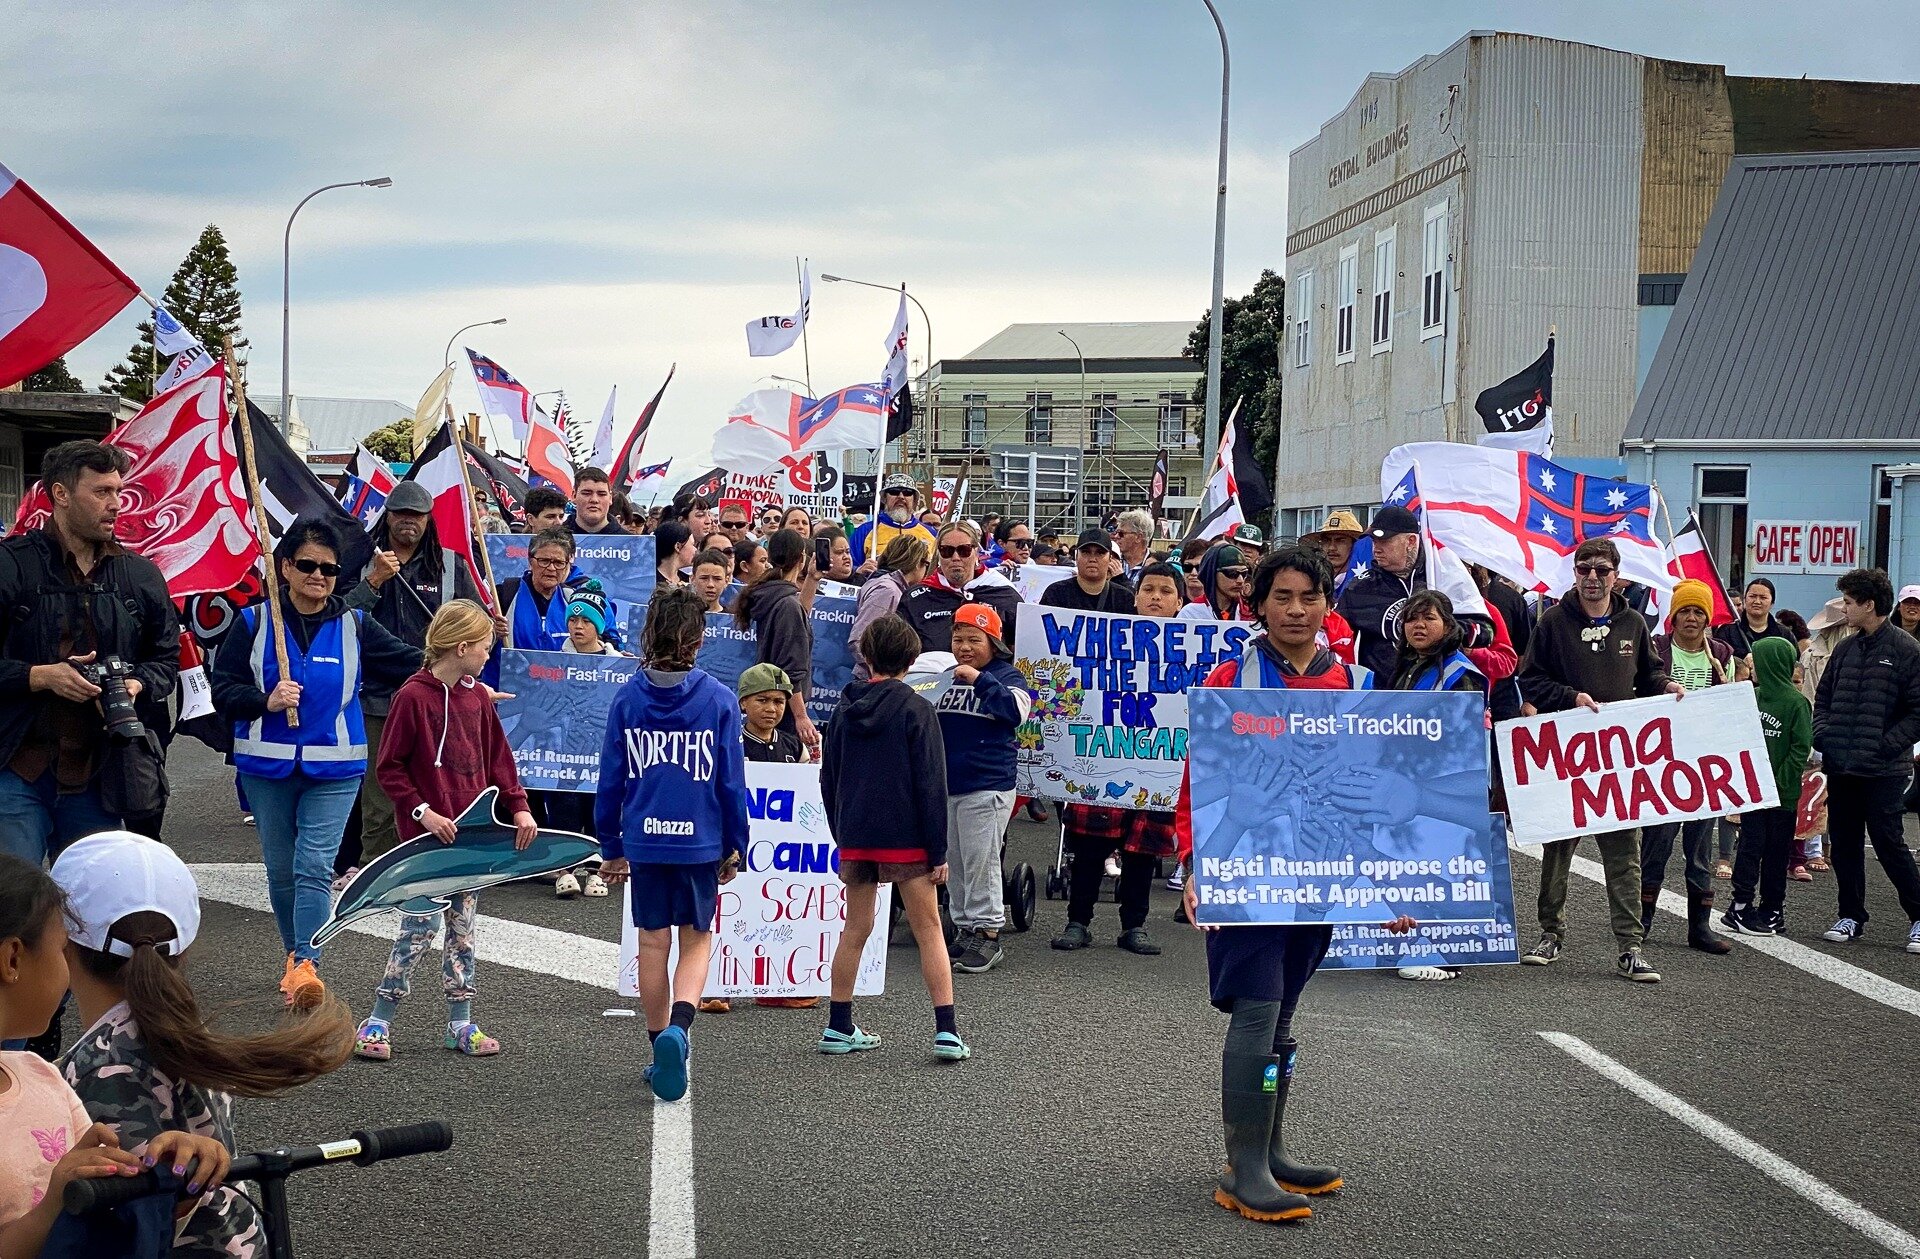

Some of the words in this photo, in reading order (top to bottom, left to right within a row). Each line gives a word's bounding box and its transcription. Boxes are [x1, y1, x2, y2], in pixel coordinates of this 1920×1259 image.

[1328, 153, 1360, 189] CENTRAL
[1366, 123, 1410, 168] BUILDINGS
[788, 494, 838, 507] TOGETHER
[505, 546, 529, 558] Sto
[573, 545, 631, 561] Tracking
[1757, 525, 1802, 563] CAFE
[1809, 525, 1856, 564] OPEN
[808, 608, 858, 624] Trackin
[704, 625, 757, 642] st-Track
[1041, 613, 1187, 664] WHERE
[1194, 624, 1251, 664] IS
[529, 664, 565, 682] Stop
[566, 666, 633, 684] Fast-Trac
[1073, 656, 1138, 693] THE
[1150, 660, 1212, 695] LOVE
[937, 688, 978, 712] GEN
[1102, 691, 1157, 729] FOR
[1232, 711, 1286, 740] Stop
[1289, 713, 1443, 742] Fast-Tracking
[1759, 711, 1782, 729] PION
[624, 727, 714, 782] NORTHS
[1068, 724, 1188, 761] TANGAR
[1511, 717, 1674, 785] Mana
[544, 751, 600, 764] Ruanui
[515, 766, 576, 781] st-Track
[1571, 749, 1763, 828] MAORI
[643, 817, 694, 835] Chazza
[1201, 854, 1264, 881] Ngāti
[1270, 855, 1354, 877] Ruanui
[1360, 859, 1441, 881] oppose
[1447, 855, 1486, 875] the
[1200, 883, 1321, 905] Fast-Track
[1327, 883, 1446, 907] Approvals
[1450, 880, 1491, 902] Bill
[1331, 924, 1354, 940] āti
[1420, 925, 1481, 940] oppose
[1483, 922, 1512, 935] the
[1325, 943, 1395, 959] st-Track
[1399, 941, 1482, 958] Approvals
[1487, 938, 1515, 952] Bill
